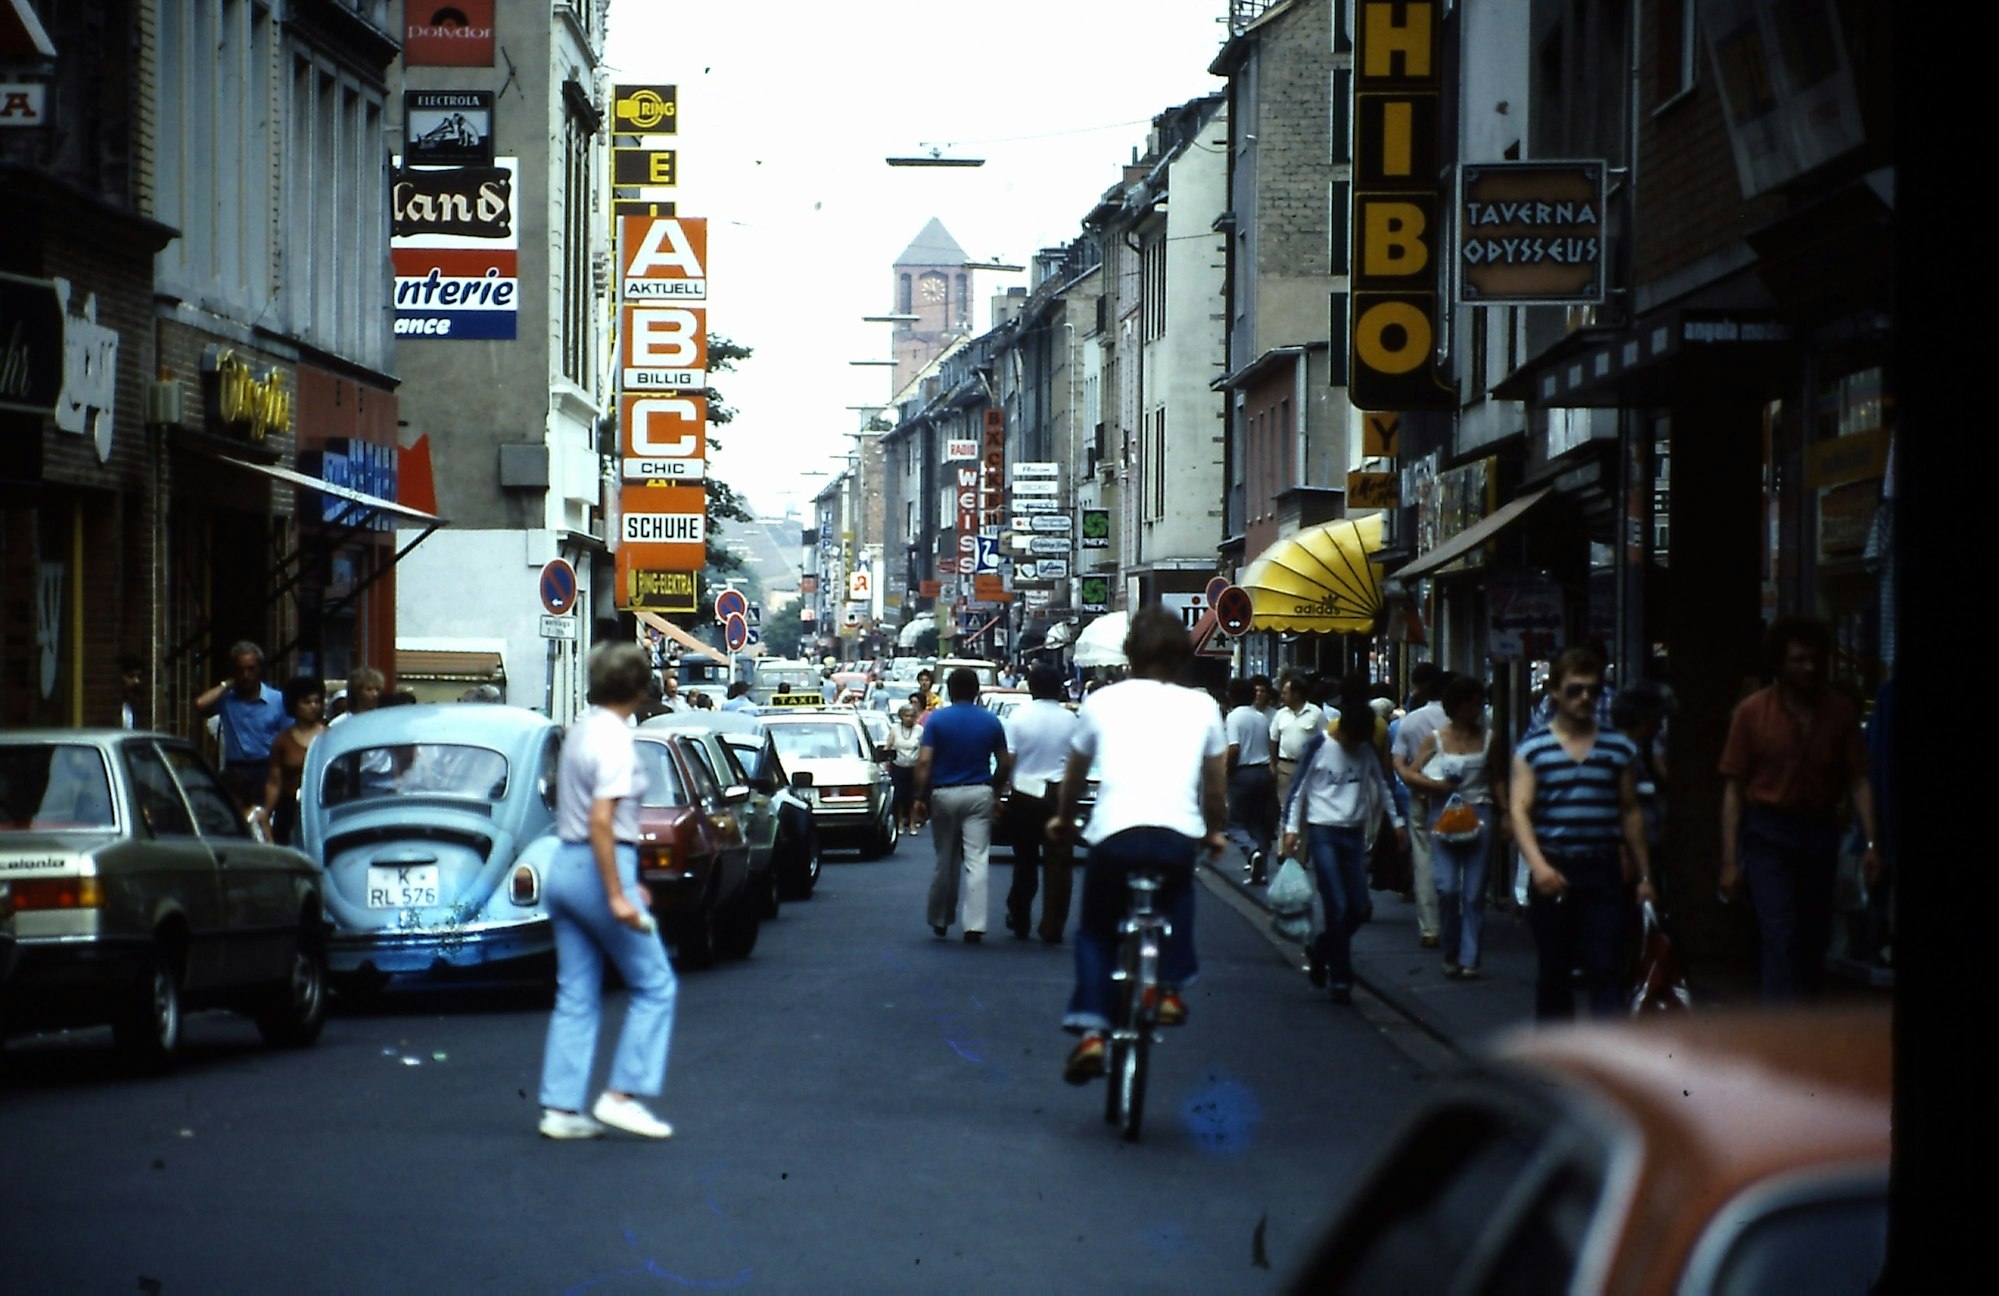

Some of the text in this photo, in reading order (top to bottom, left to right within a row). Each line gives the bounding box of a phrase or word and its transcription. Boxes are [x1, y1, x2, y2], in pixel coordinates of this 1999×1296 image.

[418, 96, 480, 107] ELECTROLA
[641, 102, 675, 116] RING
[1468, 202, 1597, 225] TAVERNA
[627, 219, 704, 277] A
[1463, 237, 1598, 263] ODYSSEUS
[628, 282, 703, 294] AKTUELL
[632, 309, 698, 366] B
[637, 372, 692, 385] BILLIG
[631, 398, 697, 457] C
[641, 462, 685, 474] CHIC
[627, 517, 699, 540] SCHUHE
[959, 469, 978, 573] WEISS
[1294, 605, 1340, 615] adidas
[779, 696, 813, 705] TAXI
[398, 868, 410, 884] K
[371, 888, 435, 905] RL 576
